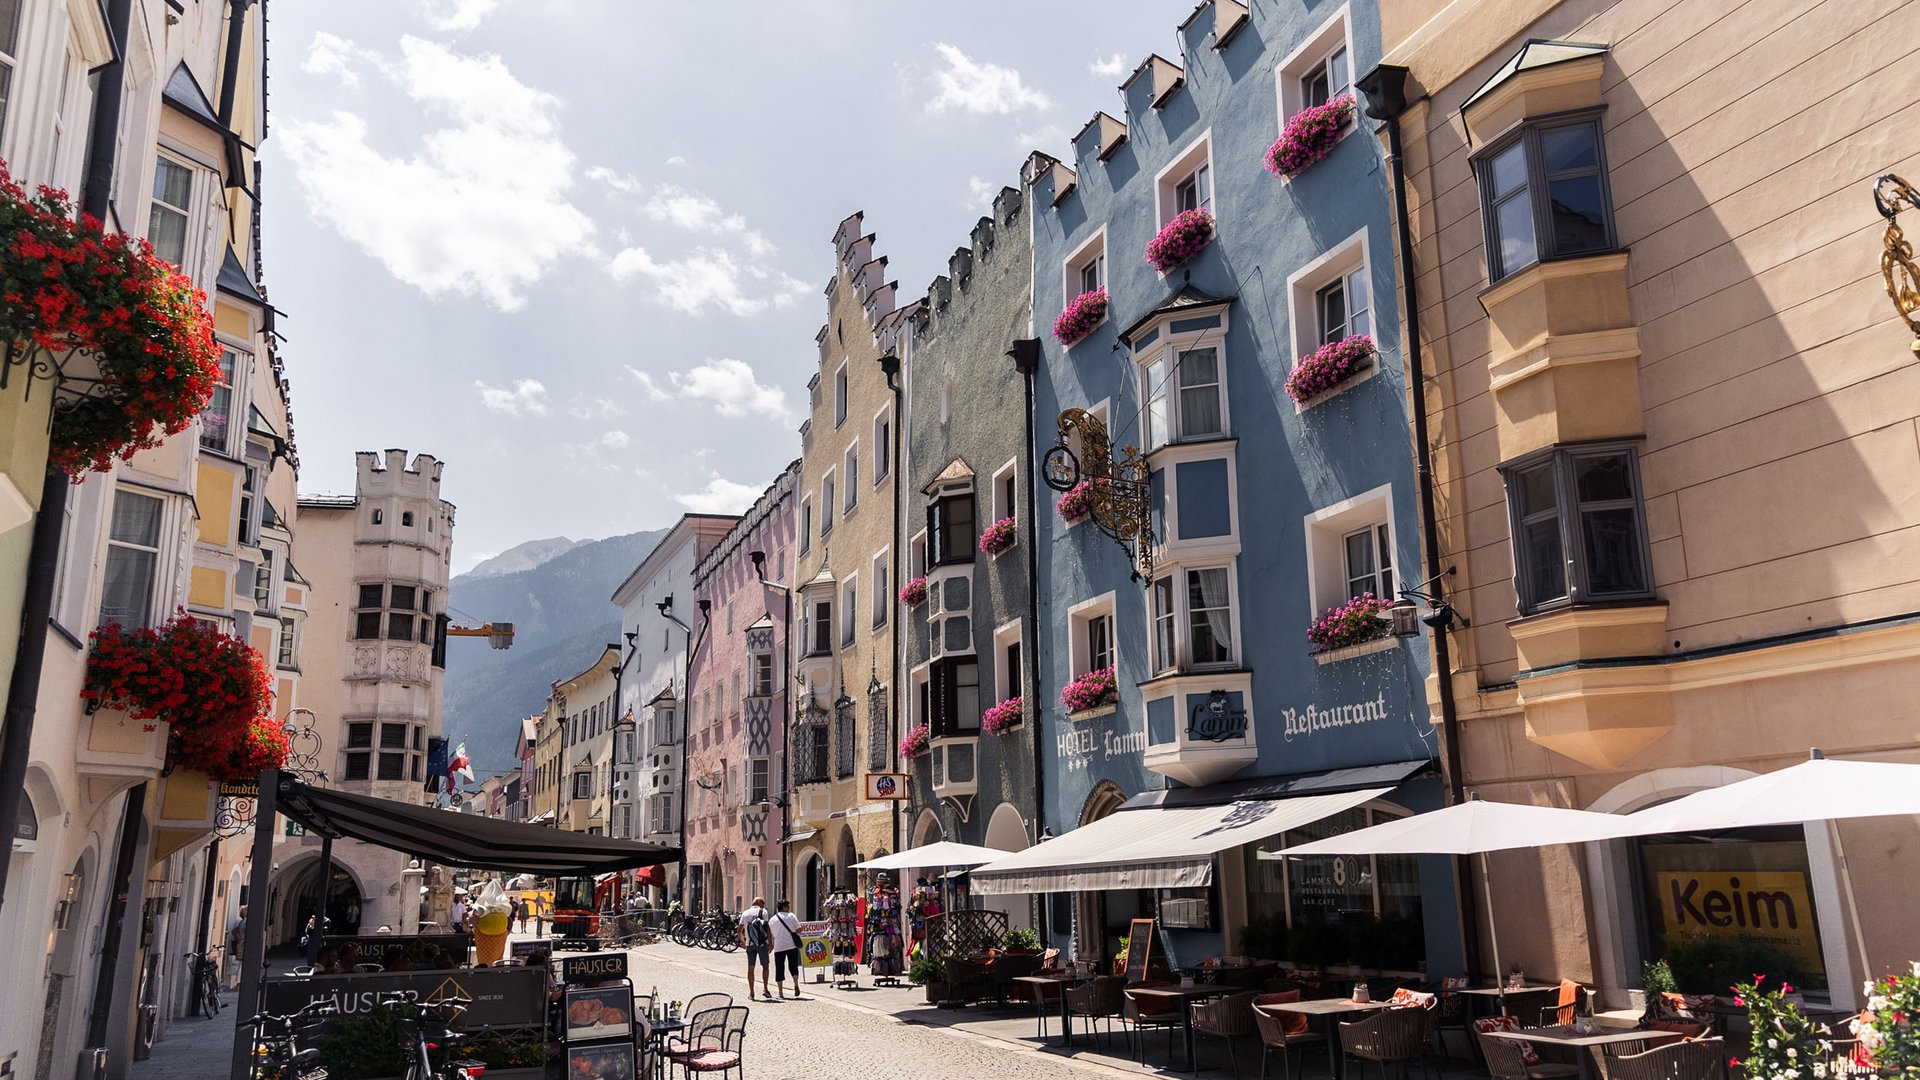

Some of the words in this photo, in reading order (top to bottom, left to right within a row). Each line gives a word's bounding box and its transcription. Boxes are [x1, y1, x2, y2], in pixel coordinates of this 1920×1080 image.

[1184, 704, 1249, 740] Lamm
[1057, 728, 1099, 757] HOTEL
[878, 777, 892, 789] HS
[879, 787, 896, 798] SHOP
[1301, 877, 1331, 885] LAMM'S
[1670, 877, 1798, 930] Keim
[807, 942, 821, 954] HS
[808, 951, 827, 964] SHOP
[569, 958, 623, 975] HÄUSLER
